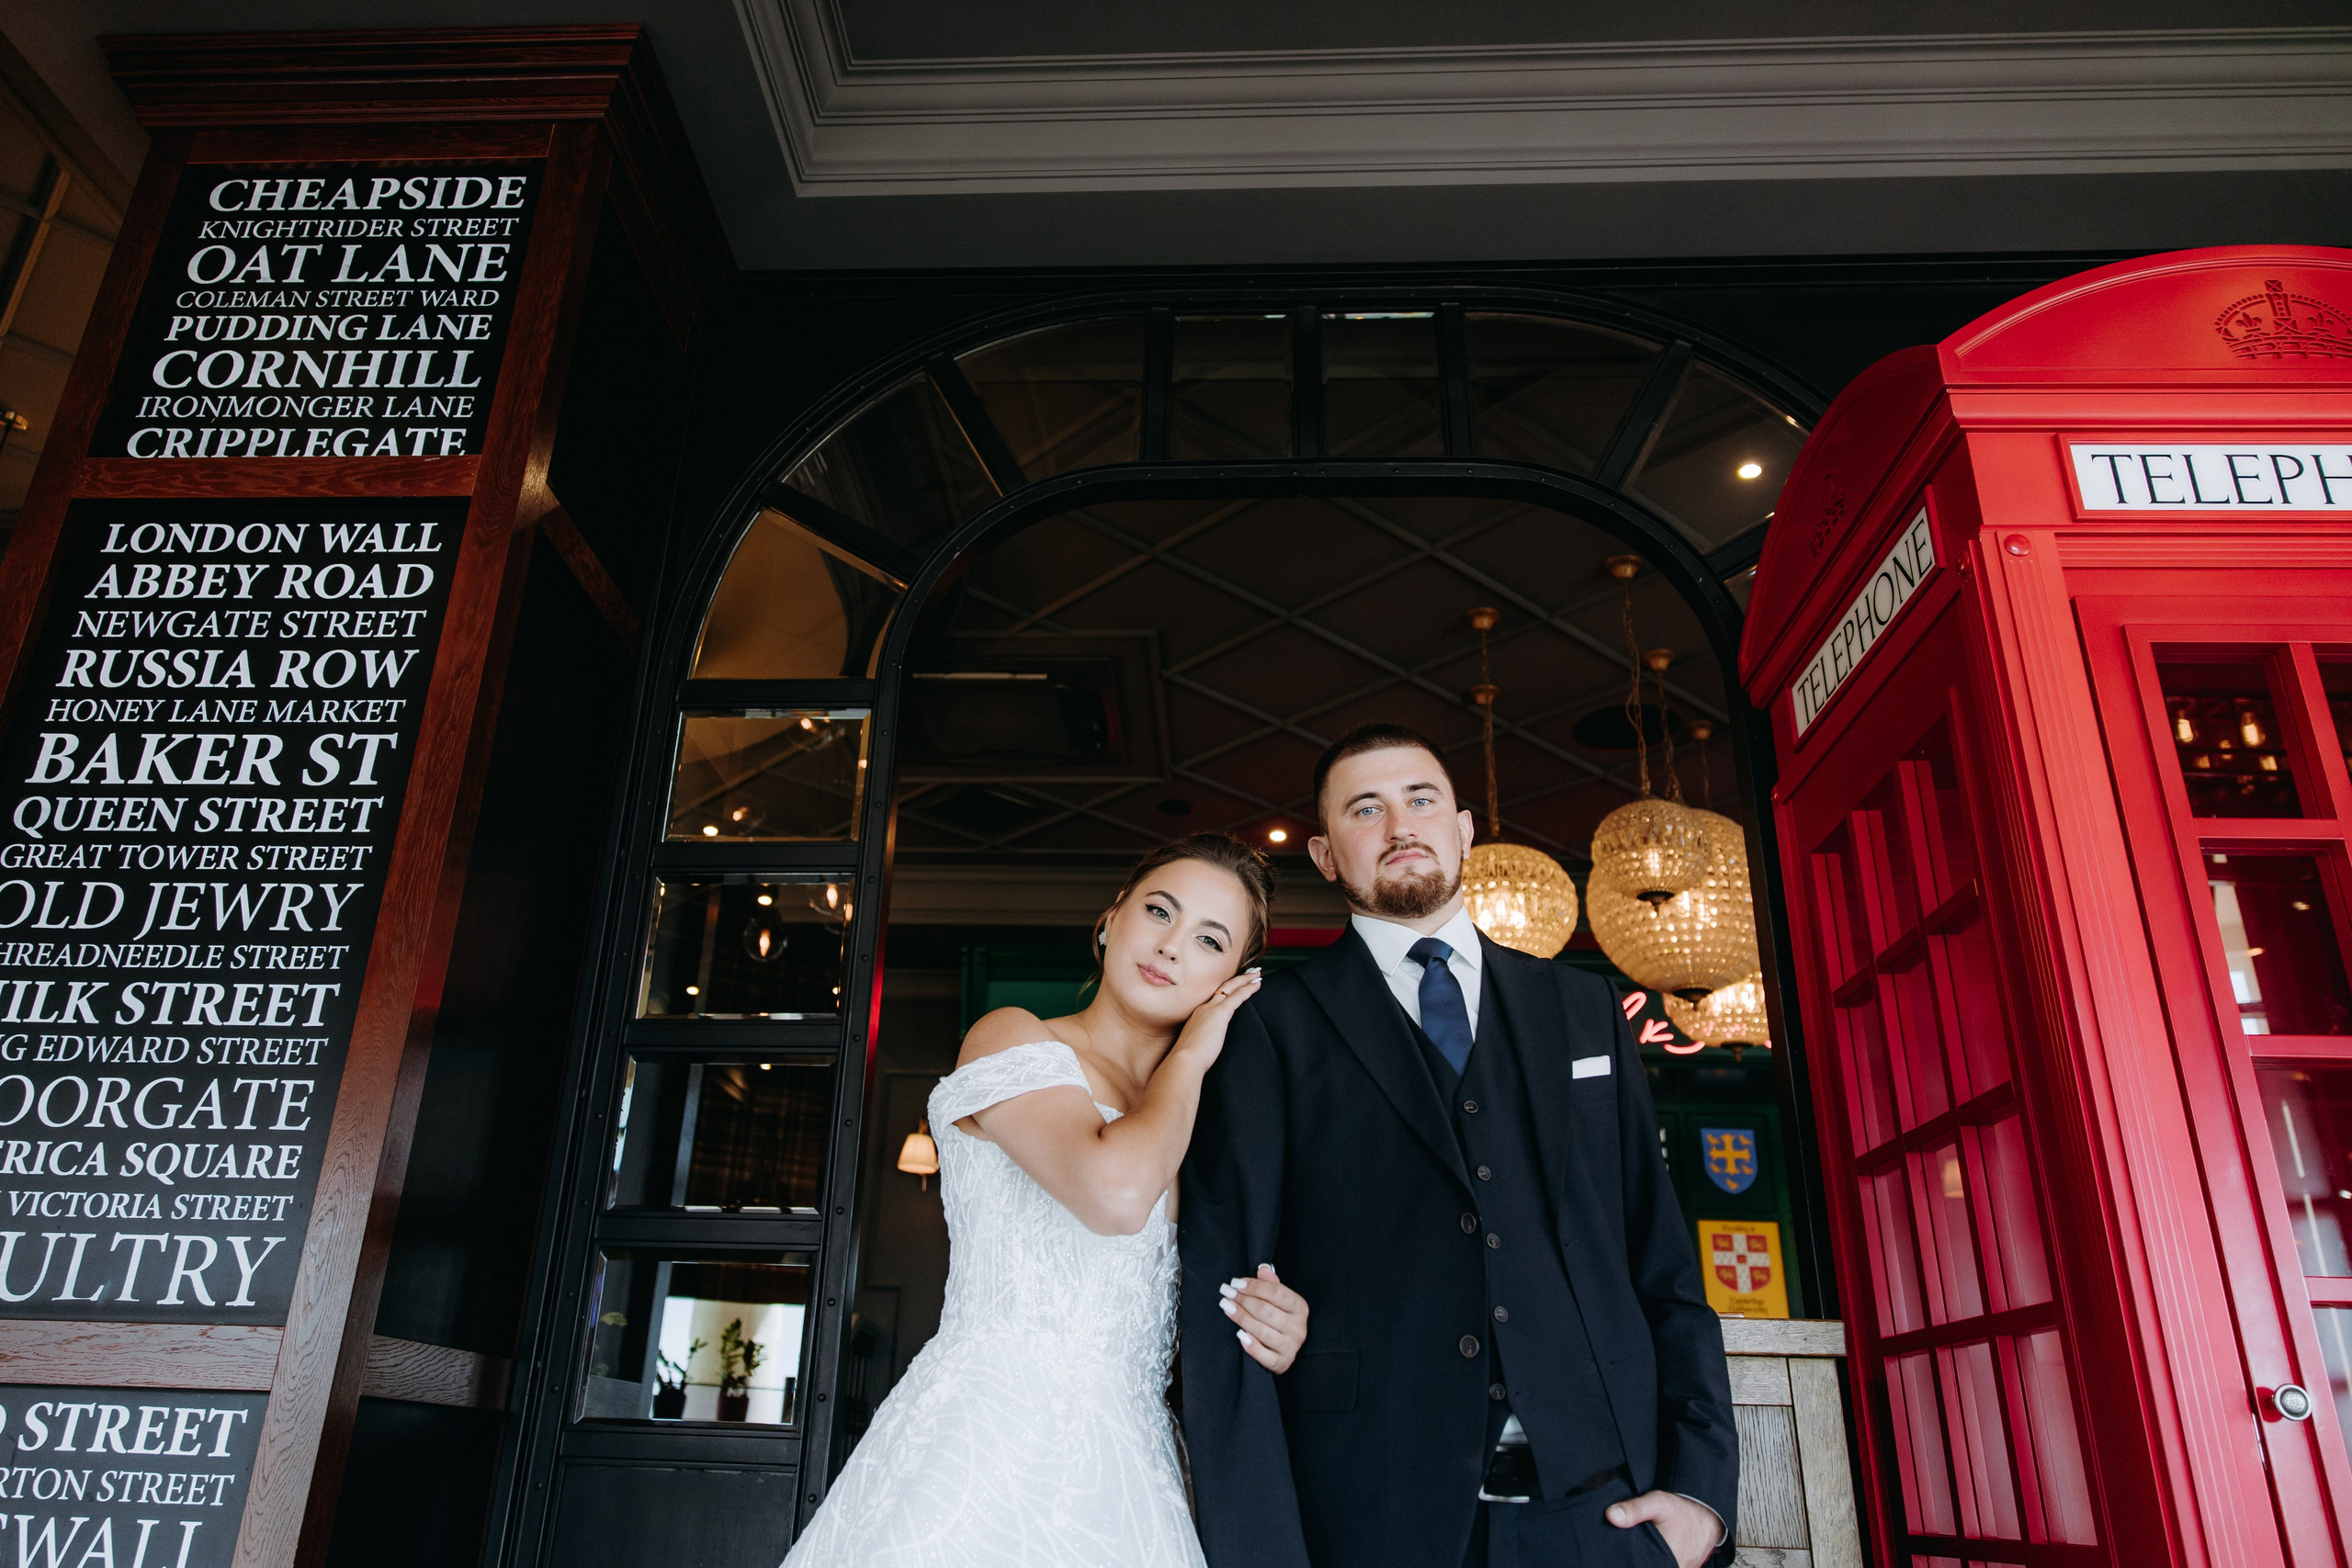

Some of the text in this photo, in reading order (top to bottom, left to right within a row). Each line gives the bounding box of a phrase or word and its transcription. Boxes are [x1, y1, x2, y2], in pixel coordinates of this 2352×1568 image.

[209, 176, 526, 212] CHEAPSIDE
[198, 218, 520, 239] KNIGHTRIDER STREET
[187, 243, 511, 285] OAT LANE
[176, 289, 500, 309] COLEMAN STREET WARD
[164, 314, 492, 342] PUDDING LANE
[153, 349, 481, 389] CORNHILL
[135, 395, 475, 419] IRONMONGER LANE
[127, 427, 467, 458] CRIPPLEGATE
[2090, 454, 2352, 505] TELEPH
[100, 522, 443, 554] LONDON WALL
[84, 563, 435, 600] ABBEY ROAD
[71, 609, 427, 638] NEWGATE STREET
[1797, 517, 1933, 726] TELEPHONE
[55, 649, 420, 689] RUSSIA ROW
[44, 698, 407, 723] HONEY LANE MARKET
[24, 732, 399, 786] BAKER ST
[13, 795, 385, 839] QUEEN STREET
[0, 843, 373, 871] GREAT TOWER STREET
[0, 879, 365, 942] OLD JEWRY
[230, 944, 350, 970] STREET
[0, 979, 341, 1027] ILK STREET
[32, 1034, 190, 1064] EDWARD
[196, 1036, 330, 1066] STREET
[0, 1139, 304, 1186] RICA SQUARE
[8, 1190, 163, 1220] VICTORIA
[170, 1193, 295, 1222] STREET
[0, 1231, 287, 1307] ULTRY
[17, 1401, 249, 1458] STREET
[96, 1470, 236, 1506] STREET
